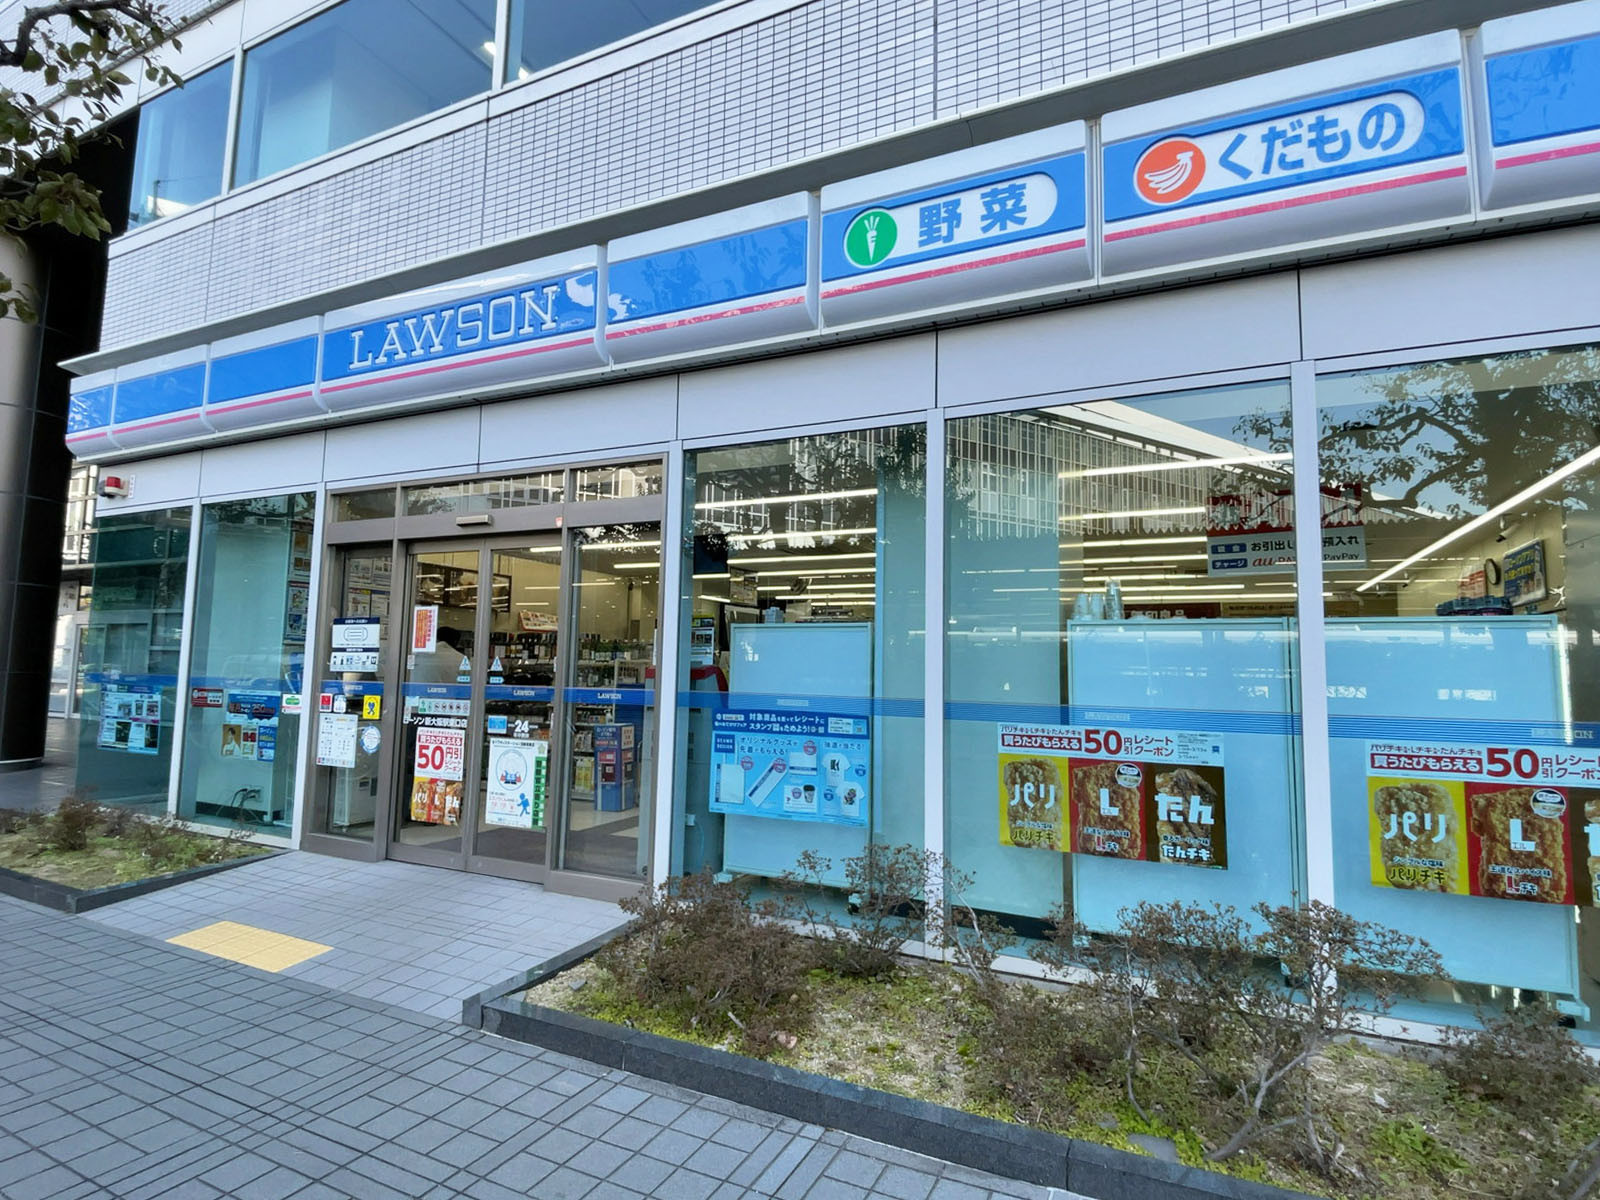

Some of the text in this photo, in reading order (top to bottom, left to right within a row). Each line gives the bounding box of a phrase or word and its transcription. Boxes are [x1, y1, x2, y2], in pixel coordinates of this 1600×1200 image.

[1218, 103, 1405, 180] くだもの
[918, 183, 1027, 248] 野菜
[348, 285, 559, 369] LAWSON
[514, 719, 529, 733] 24
[1003, 735, 1080, 749] 買うたびもらえる
[1084, 729, 1123, 755] 50
[1134, 735, 1174, 746] レシート
[1134, 746, 1174, 757] クーポン
[417, 745, 445, 770] 50
[1373, 754, 1480, 771] 買うたびもらえる
[1486, 748, 1539, 779] 50
[1010, 782, 1056, 809] パリ
[1100, 788, 1119, 816] L
[1155, 794, 1215, 825] たん
[1013, 830, 1054, 842] パリチキ
[1384, 813, 1446, 843] パリ
[1509, 818, 1535, 851] L
[1162, 844, 1211, 862] たんチキ
[1391, 868, 1446, 884] パリチキ
